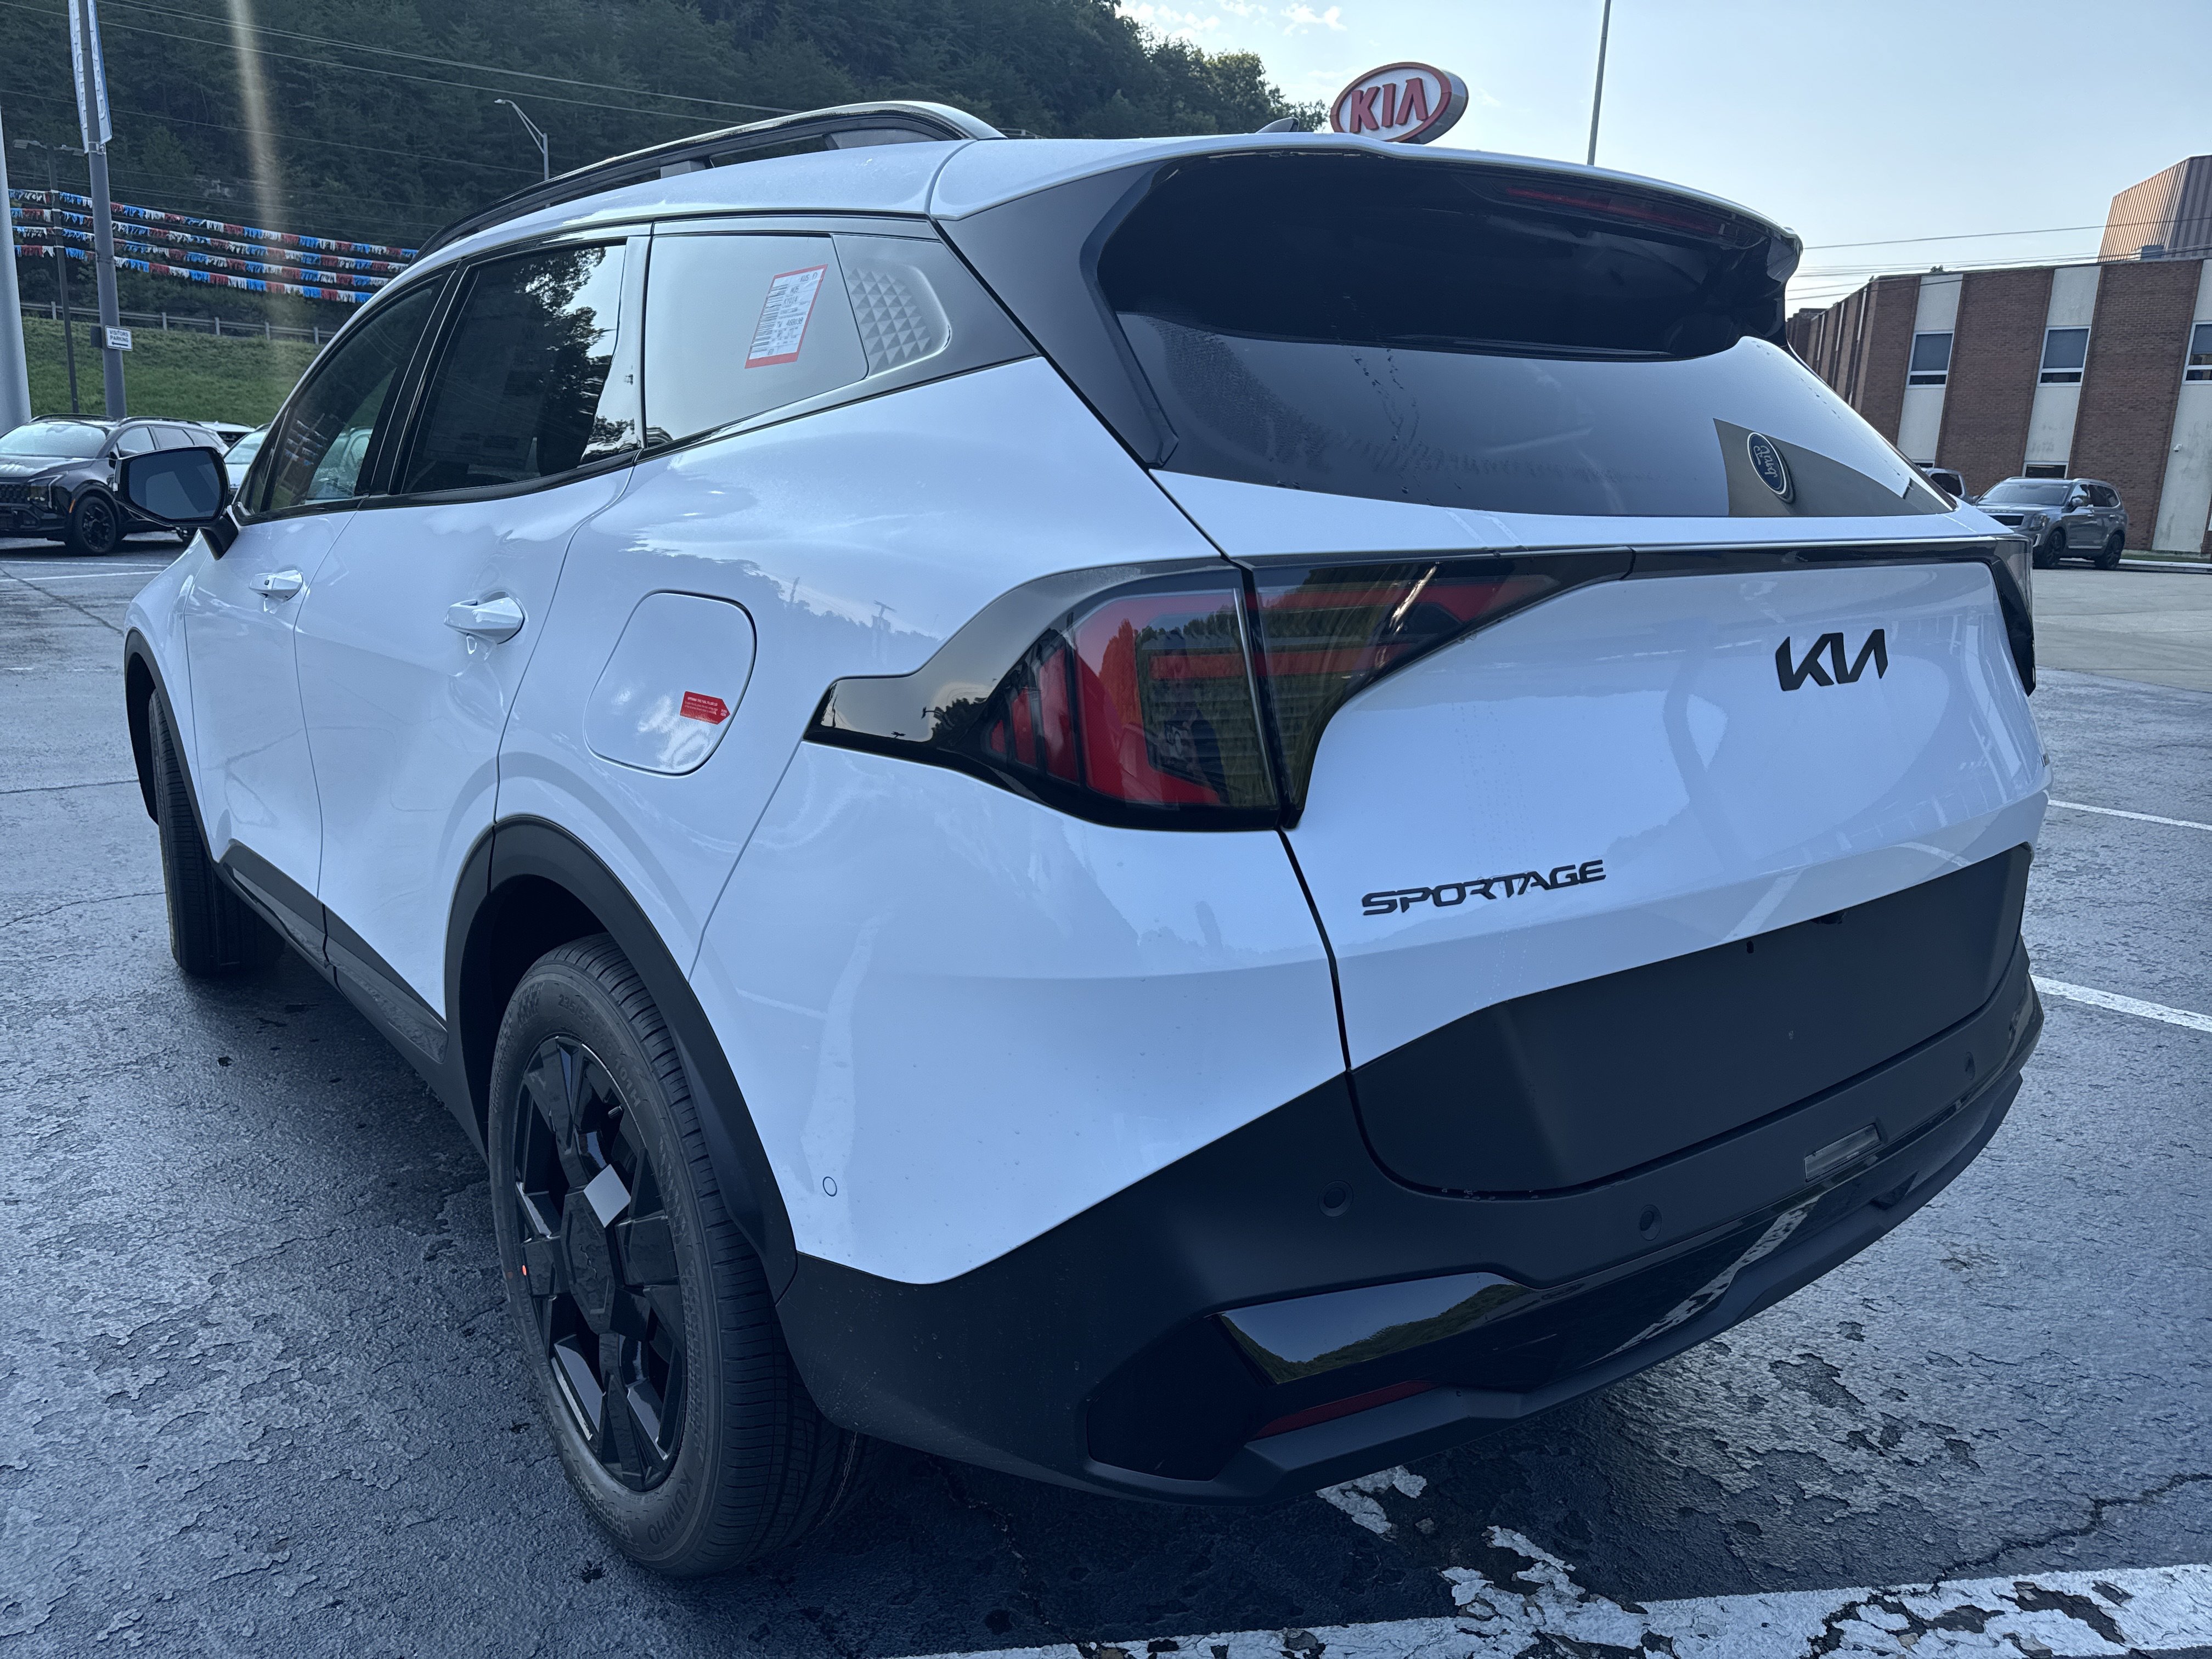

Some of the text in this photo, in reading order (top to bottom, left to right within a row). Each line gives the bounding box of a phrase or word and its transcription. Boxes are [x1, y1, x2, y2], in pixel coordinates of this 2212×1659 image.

[1350, 77, 1429, 134] KIA
[1775, 628, 1888, 691] KIA
[1361, 859, 1607, 916] SPORTAGE
[647, 1468, 693, 1545] KUMHO
